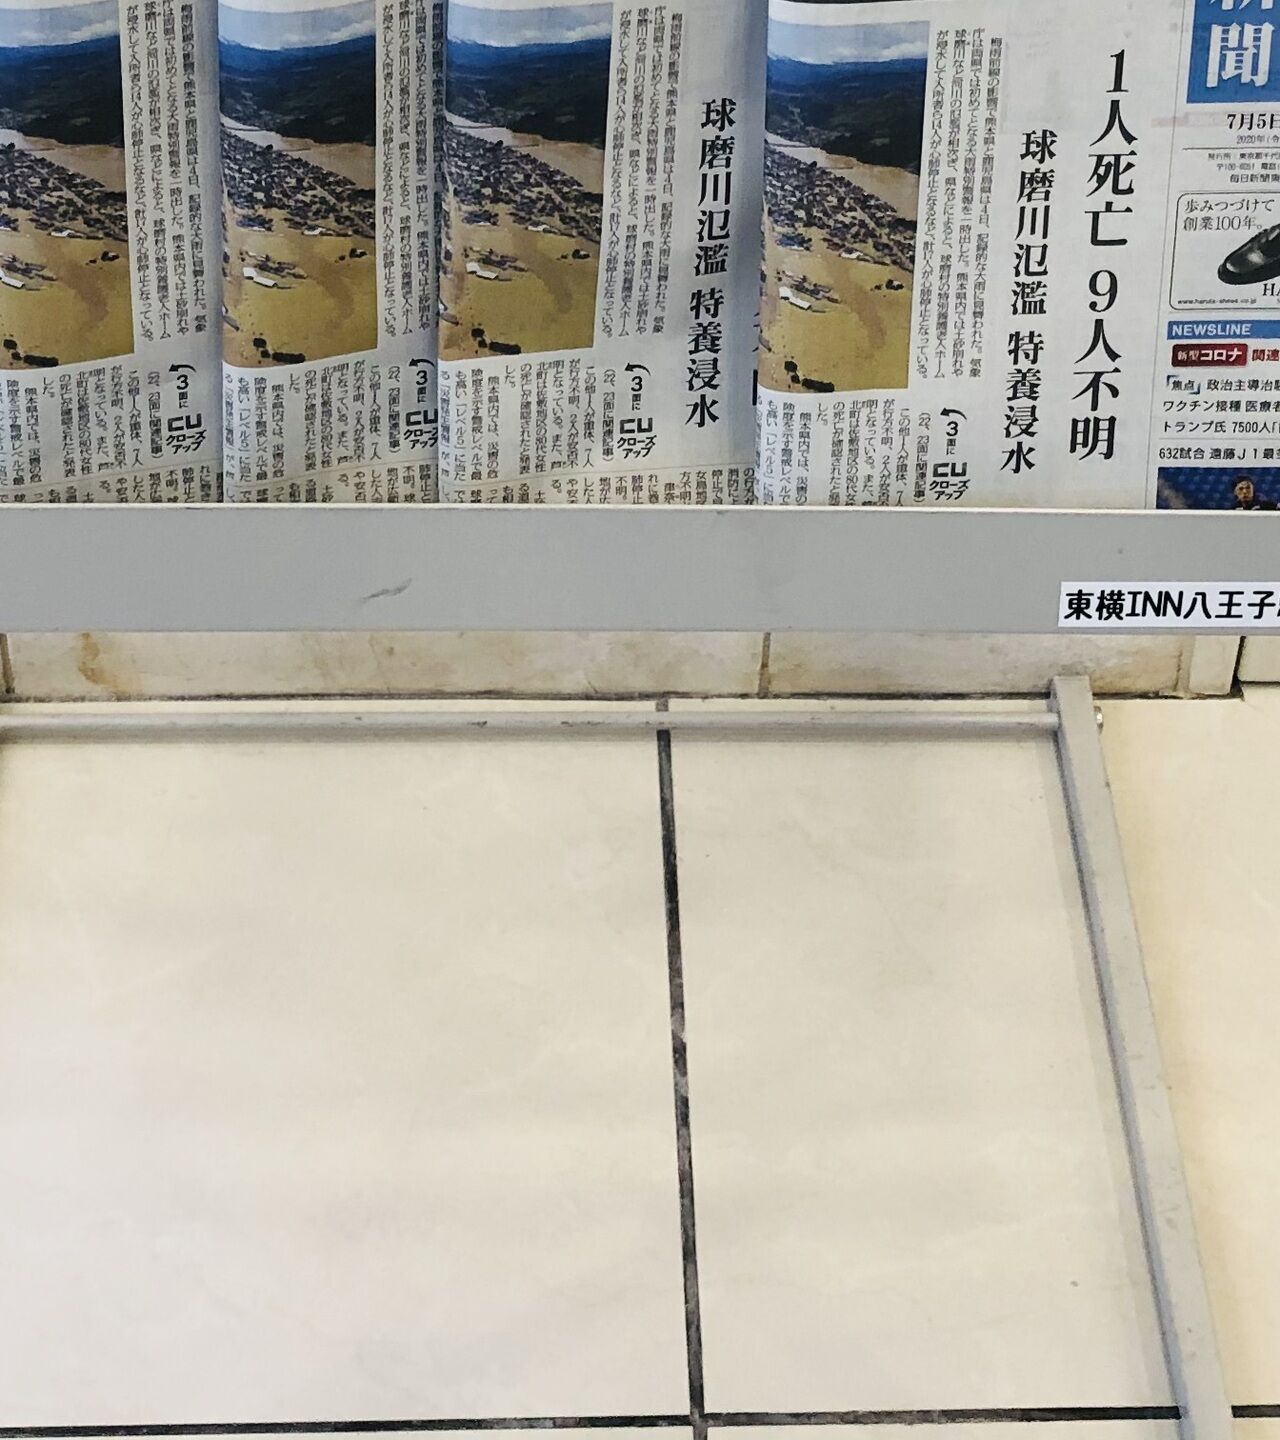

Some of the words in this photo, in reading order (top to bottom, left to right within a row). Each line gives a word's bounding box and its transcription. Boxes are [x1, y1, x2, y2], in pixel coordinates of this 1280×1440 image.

[1084, 48, 1140, 248] 1人死亡
[693, 97, 738, 277] 球磨川氾濫
[1184, 198, 1276, 212] 歩みつづけて
[1010, 128, 1058, 316] 球磨川氾濫
[1182, 216, 1264, 232] 創業100年。
[1171, 323, 1252, 337] NEWSLINE
[683, 287, 726, 428] 特養浸水
[1176, 347, 1244, 362] 新型コロナ
[1068, 267, 1123, 462] 9人不明
[1166, 374, 1202, 395] 「焦点」
[999, 329, 1047, 475] 特養浸水
[1163, 399, 1242, 413] ワクチン接種
[1163, 421, 1227, 434] トランプ氏
[165, 429, 207, 447] クローズ
[616, 434, 659, 450] クローズ
[171, 440, 203, 455] アップ
[622, 447, 654, 459] アップ
[1158, 447, 1206, 460] 632試合
[929, 478, 969, 492] クローズ
[933, 489, 963, 502] アップ
